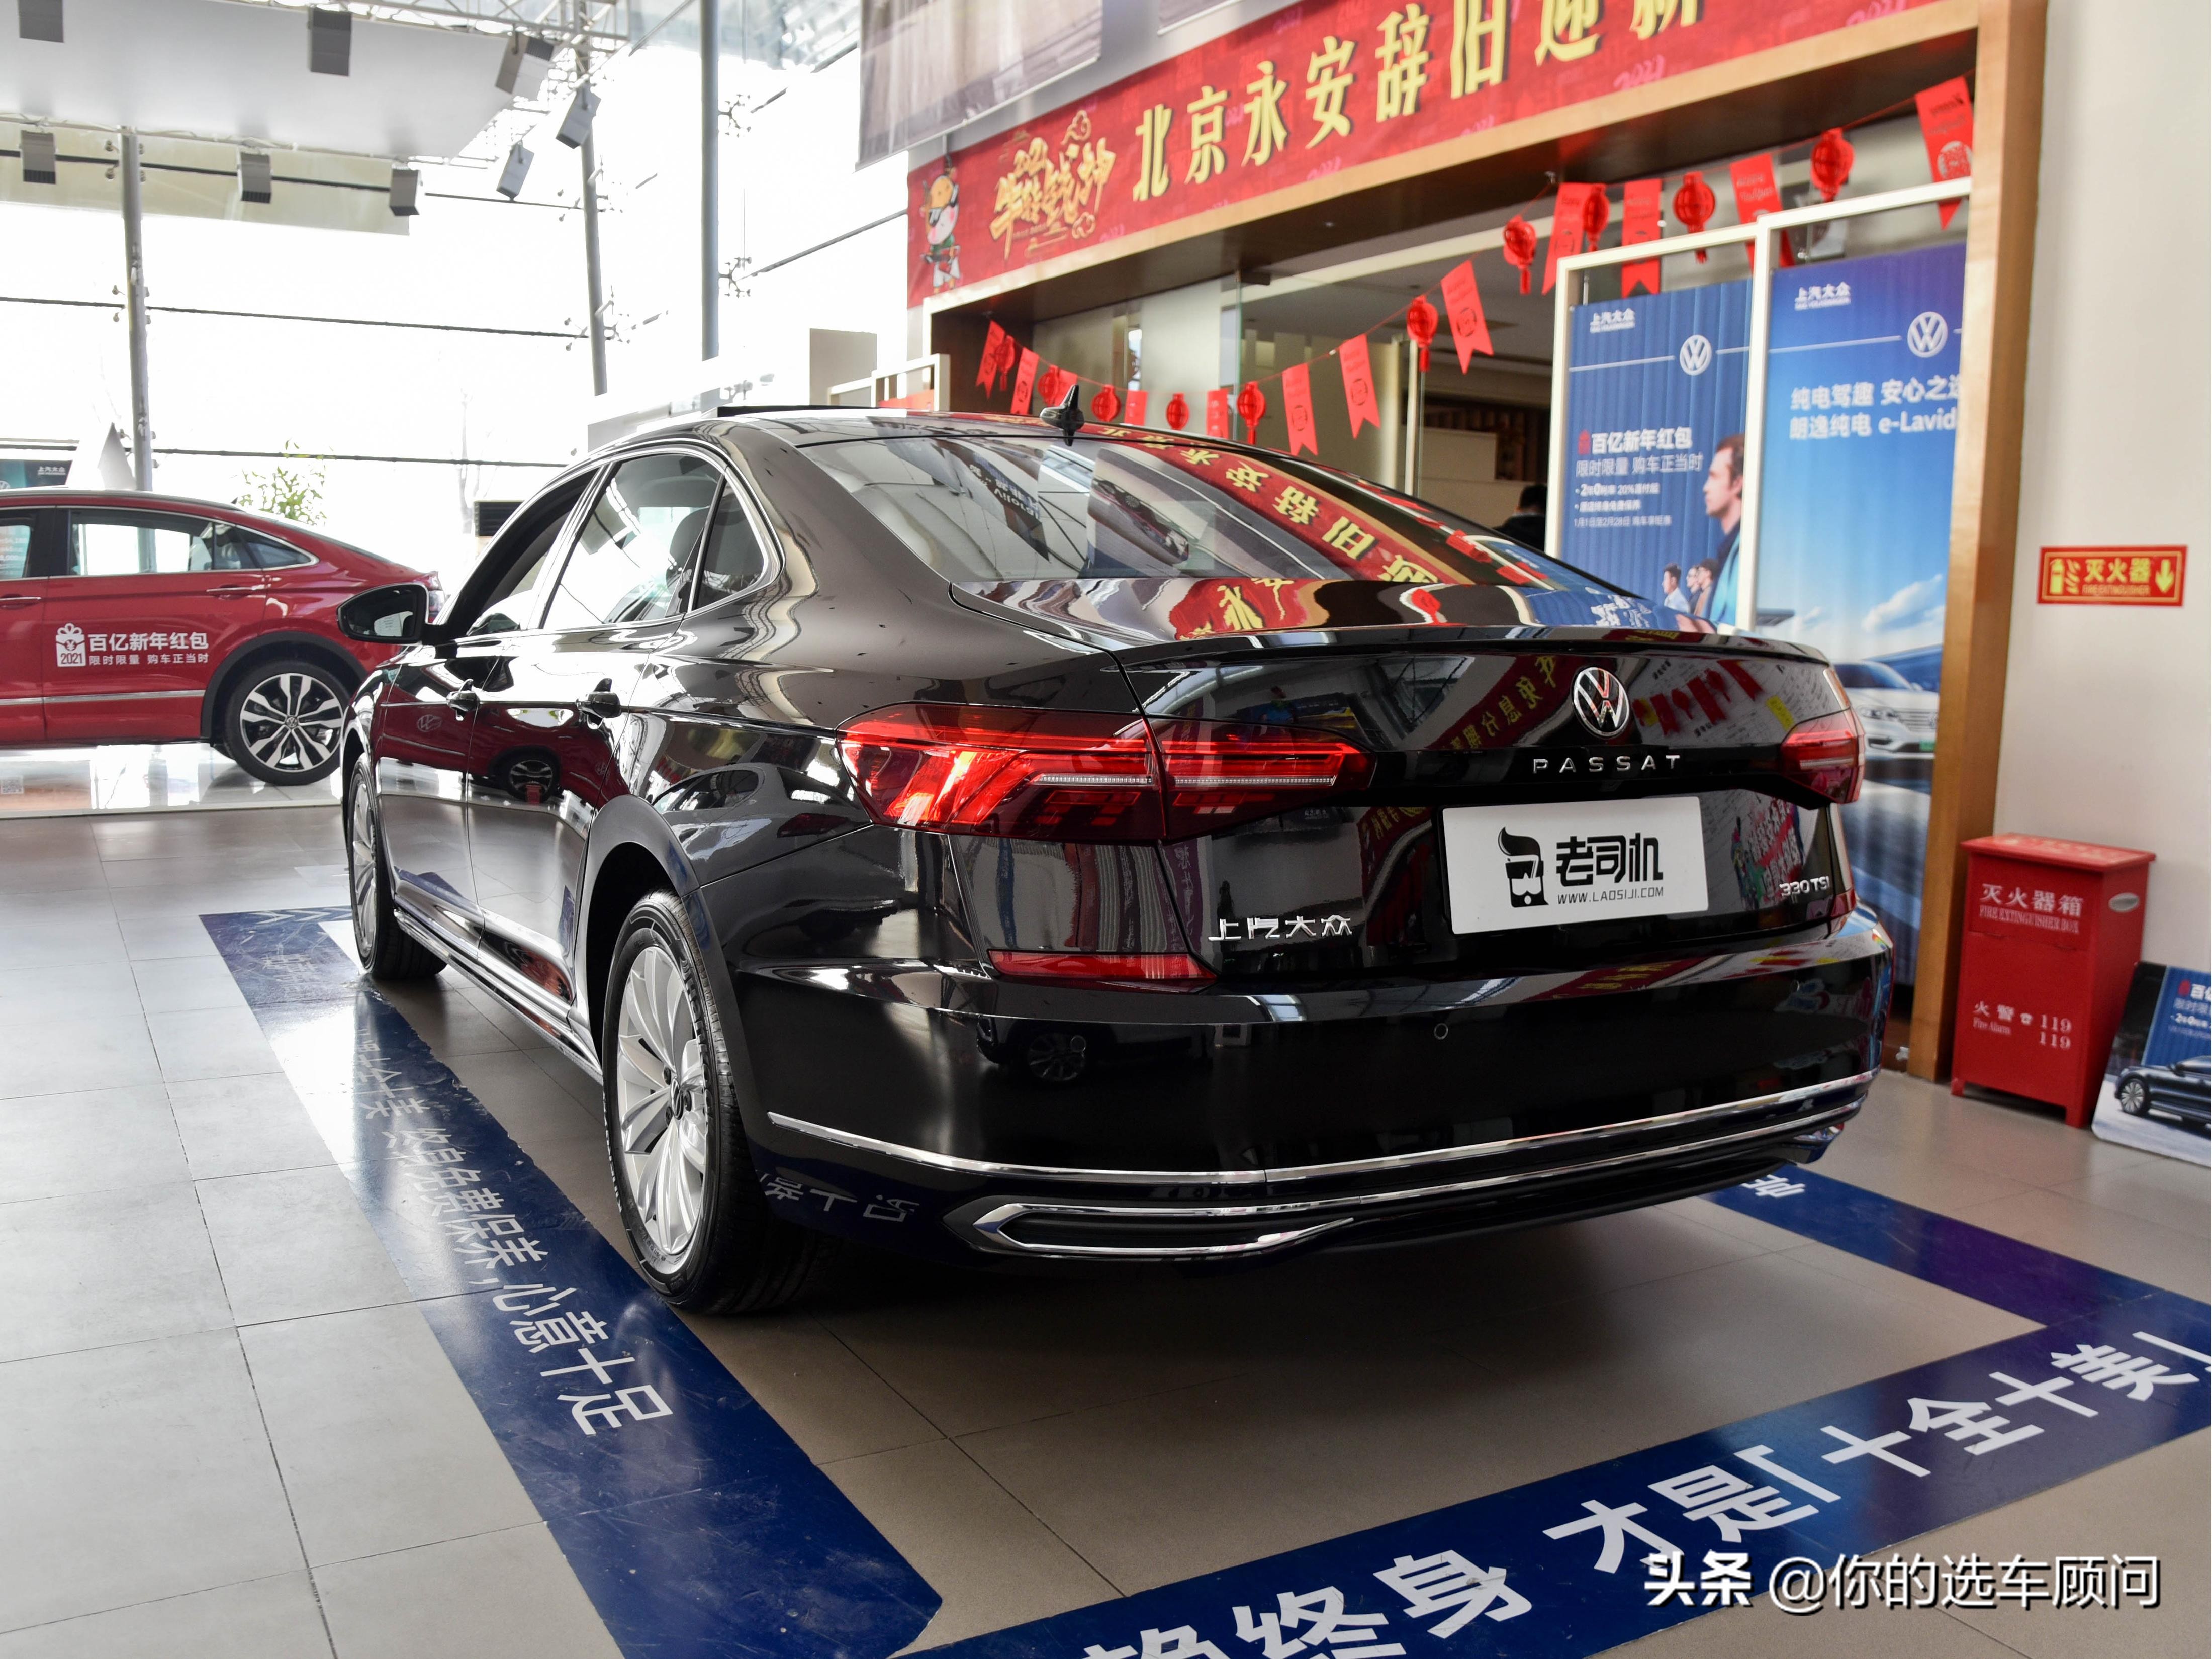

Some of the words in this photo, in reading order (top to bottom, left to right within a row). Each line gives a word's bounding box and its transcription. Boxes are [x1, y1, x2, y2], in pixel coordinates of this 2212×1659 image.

[1790, 381, 1875, 411] 纯电驾趣
[1591, 426, 1693, 454] 百亿新年红包
[1576, 457, 1629, 477] 限时限量
[1631, 451, 1704, 475] 购车正当时
[2084, 557, 2151, 583] 灭火器
[87, 631, 209, 652] 百亿新年红包
[60, 652, 83, 665] 2021
[88, 654, 140, 666] 限时限量
[147, 653, 209, 665] 购车正当时
[1532, 755, 1680, 774] PASSAT
[1556, 832, 1664, 887] 老司机
[1557, 886, 1664, 905] WWW.LAOSIJI.COM
[1979, 883, 2084, 917] 灭火器箱
[1208, 915, 1352, 941] 上汽大众
[2041, 1014, 2072, 1033] 119
[2040, 1031, 2071, 1049] 119
